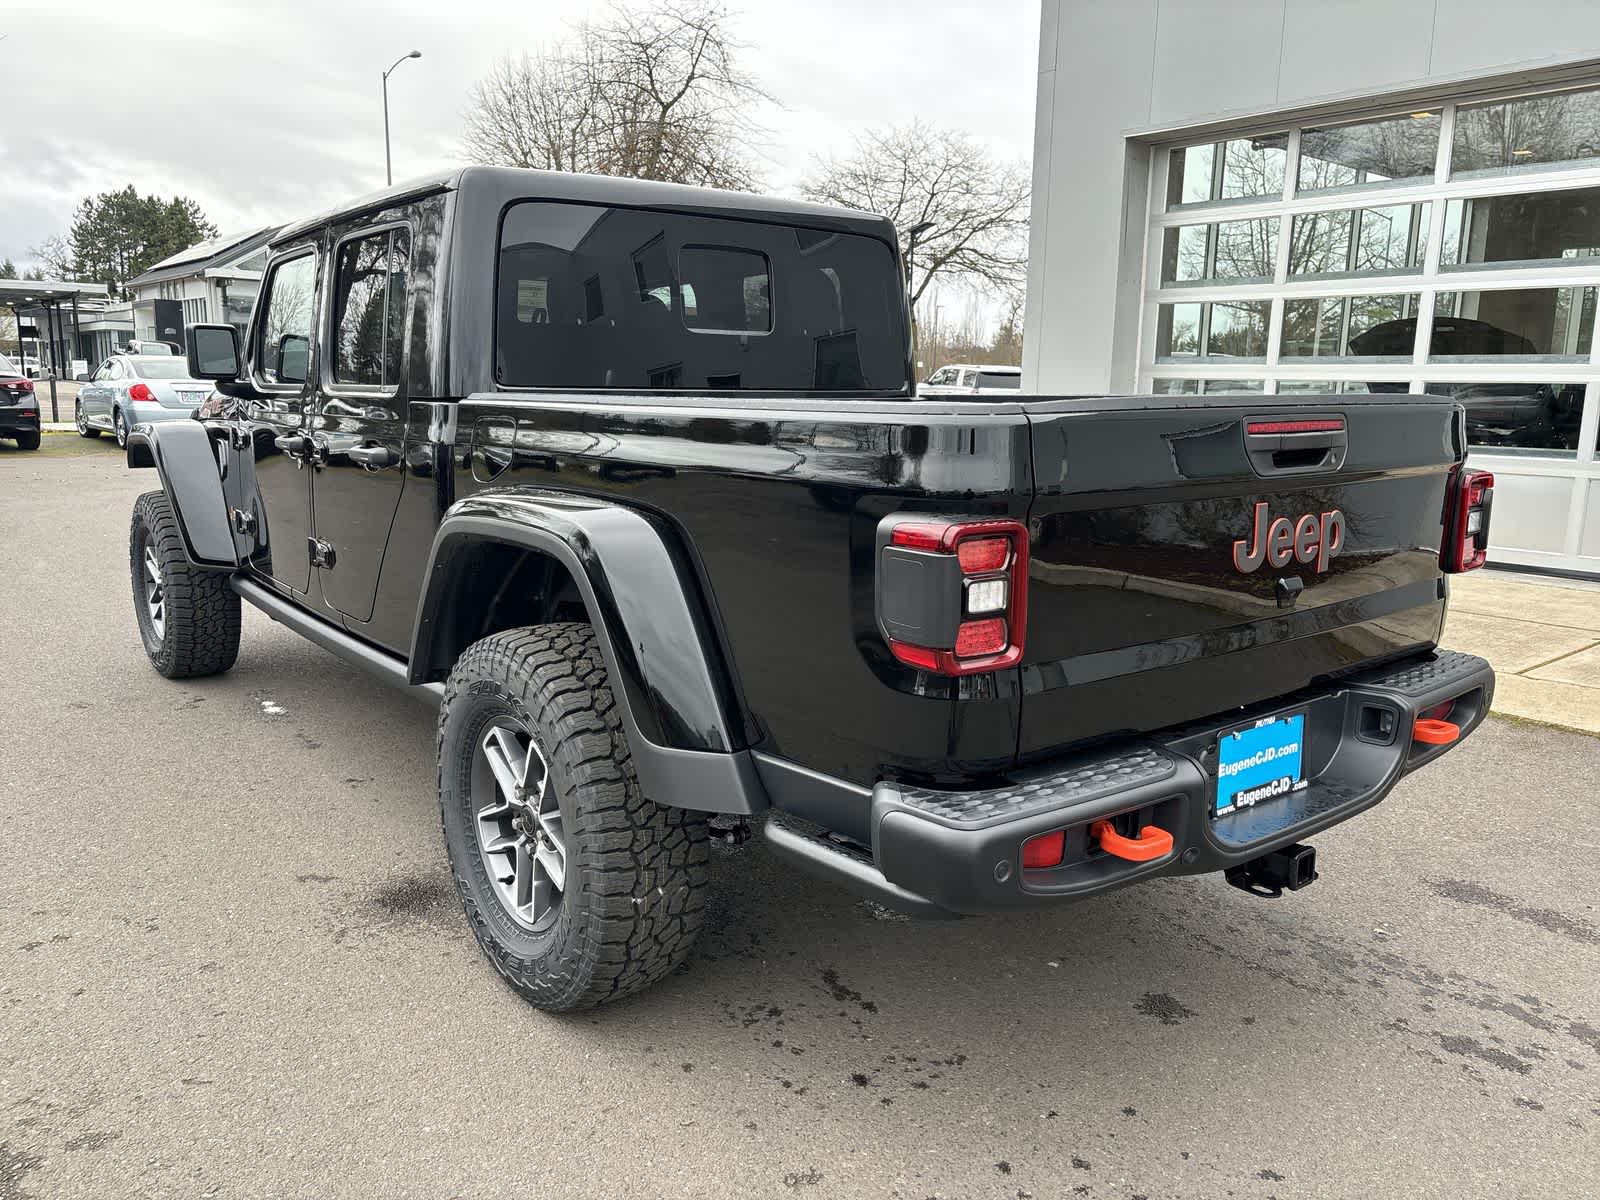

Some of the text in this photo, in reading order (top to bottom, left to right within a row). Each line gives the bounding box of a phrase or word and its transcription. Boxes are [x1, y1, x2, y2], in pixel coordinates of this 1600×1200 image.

[1232, 501, 1346, 574] Jeep
[1218, 742, 1299, 777] EugeneCJD.com
[1236, 776, 1290, 807] EugeneCJD
